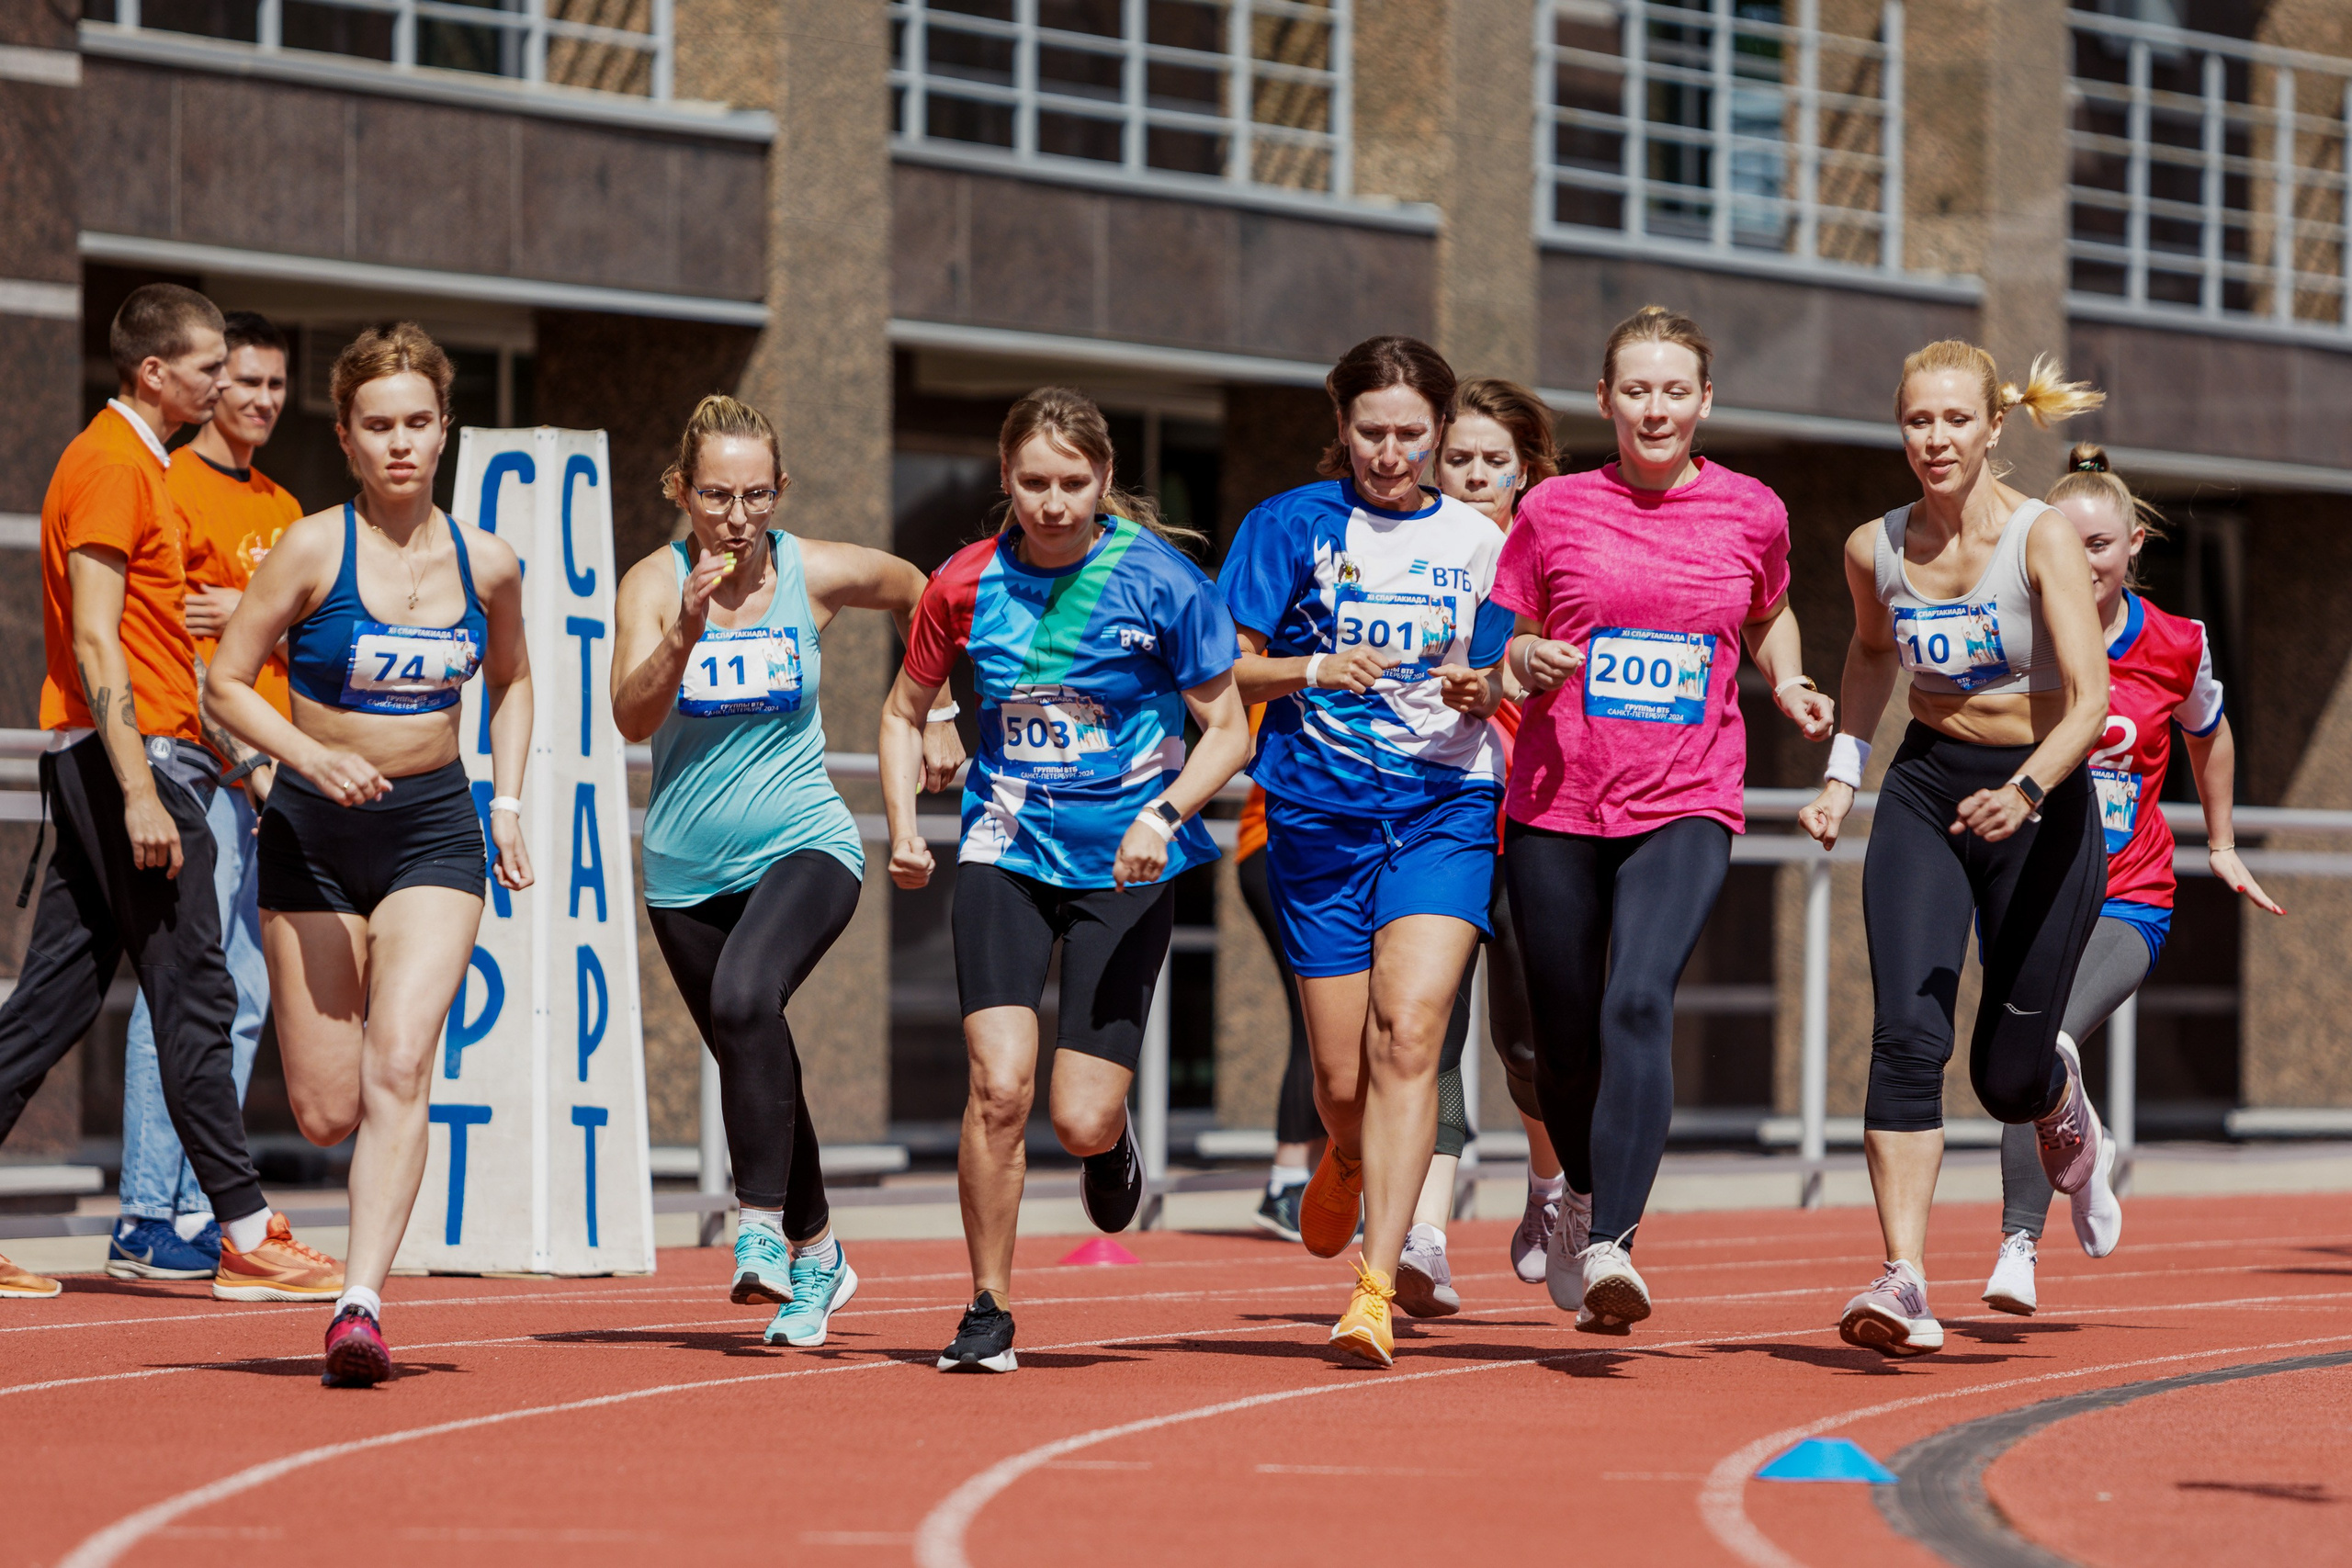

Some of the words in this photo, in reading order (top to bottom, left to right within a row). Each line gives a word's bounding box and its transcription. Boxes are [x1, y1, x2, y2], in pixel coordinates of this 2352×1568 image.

[1432, 567, 1472, 592] ВТБ
[1375, 594, 1427, 604] СПАРТАКИАДА
[1917, 607, 1966, 618] СПАРТАКИАДА
[397, 627, 452, 640] СПАРТАКИАДА
[715, 629, 768, 640] СПАРТАКИАДА
[1119, 629, 1157, 650] ВТБ
[1341, 617, 1413, 650] 301
[1631, 630, 1686, 642] СПАРТАКИАДА
[1907, 633, 1950, 664] 10
[372, 652, 426, 682] 74
[700, 655, 745, 687] 11
[1400, 667, 1415, 675] ВТБ
[1595, 653, 1673, 688] 200
[1383, 671, 1413, 680] ЕТЕРБУРГ
[704, 705, 763, 716] САНКТ-ПЕТЕРБУРГ
[720, 702, 750, 710] ГРУППЫ
[1624, 704, 1656, 713] ГРУППЫ
[1607, 708, 1668, 720] САНКТ-ПЕТЕРБУРГ
[1668, 713, 1684, 721] 2024
[1007, 716, 1070, 749] 503
[2087, 715, 2138, 771] 2
[1021, 772, 1077, 780] САНКТ-ПЕТЕРБУРГ
[1078, 769, 1094, 777] 2024
[429, 450, 536, 1246] СРТ
[561, 454, 608, 1247] СТАРТ
